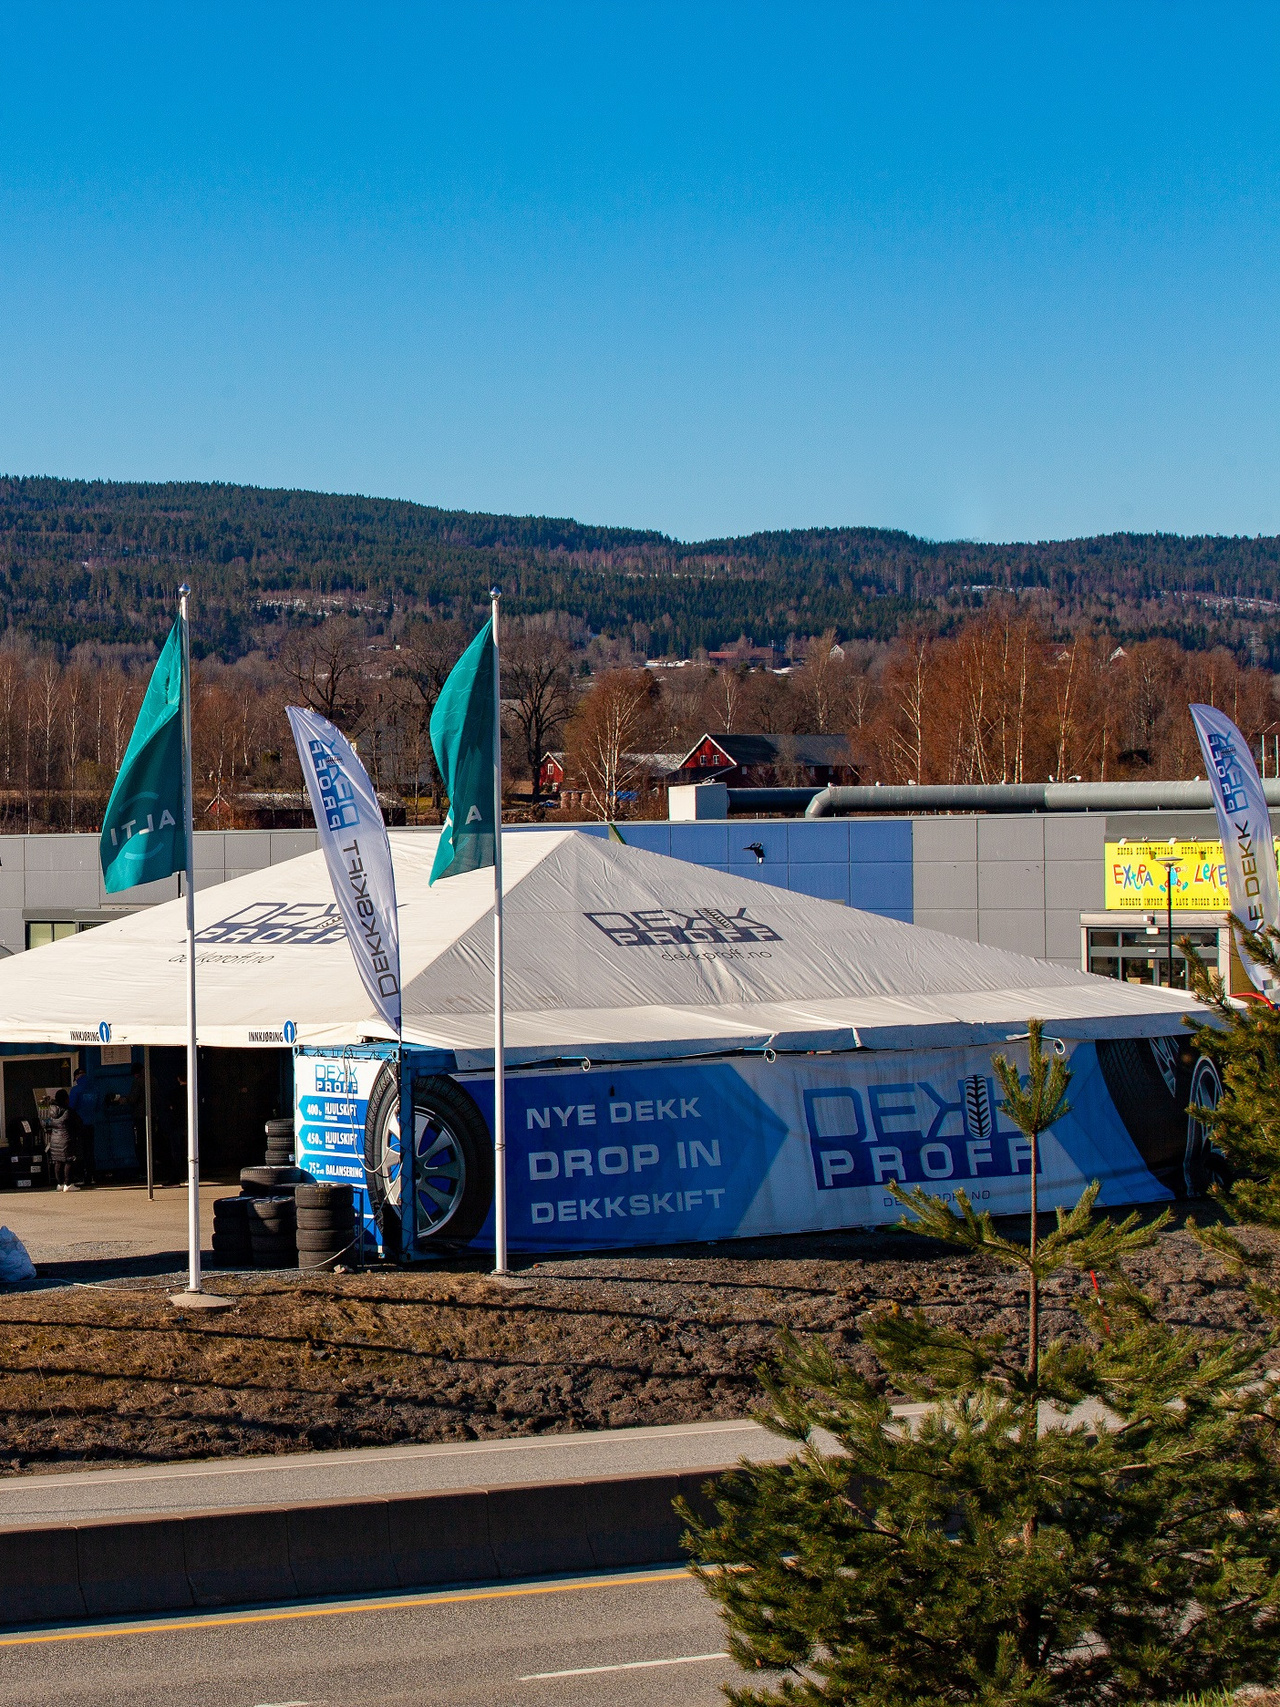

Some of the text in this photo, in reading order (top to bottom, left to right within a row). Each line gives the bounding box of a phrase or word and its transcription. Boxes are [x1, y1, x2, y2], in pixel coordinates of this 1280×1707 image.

[610, 927, 773, 946] PROFF
[661, 948, 772, 963] dekkproff.no
[248, 1031, 284, 1043] INNKJØRING
[526, 1097, 702, 1130] NYE DEKK
[528, 1139, 722, 1181] DROP IN
[531, 1188, 726, 1225] DEKKSKIFT
